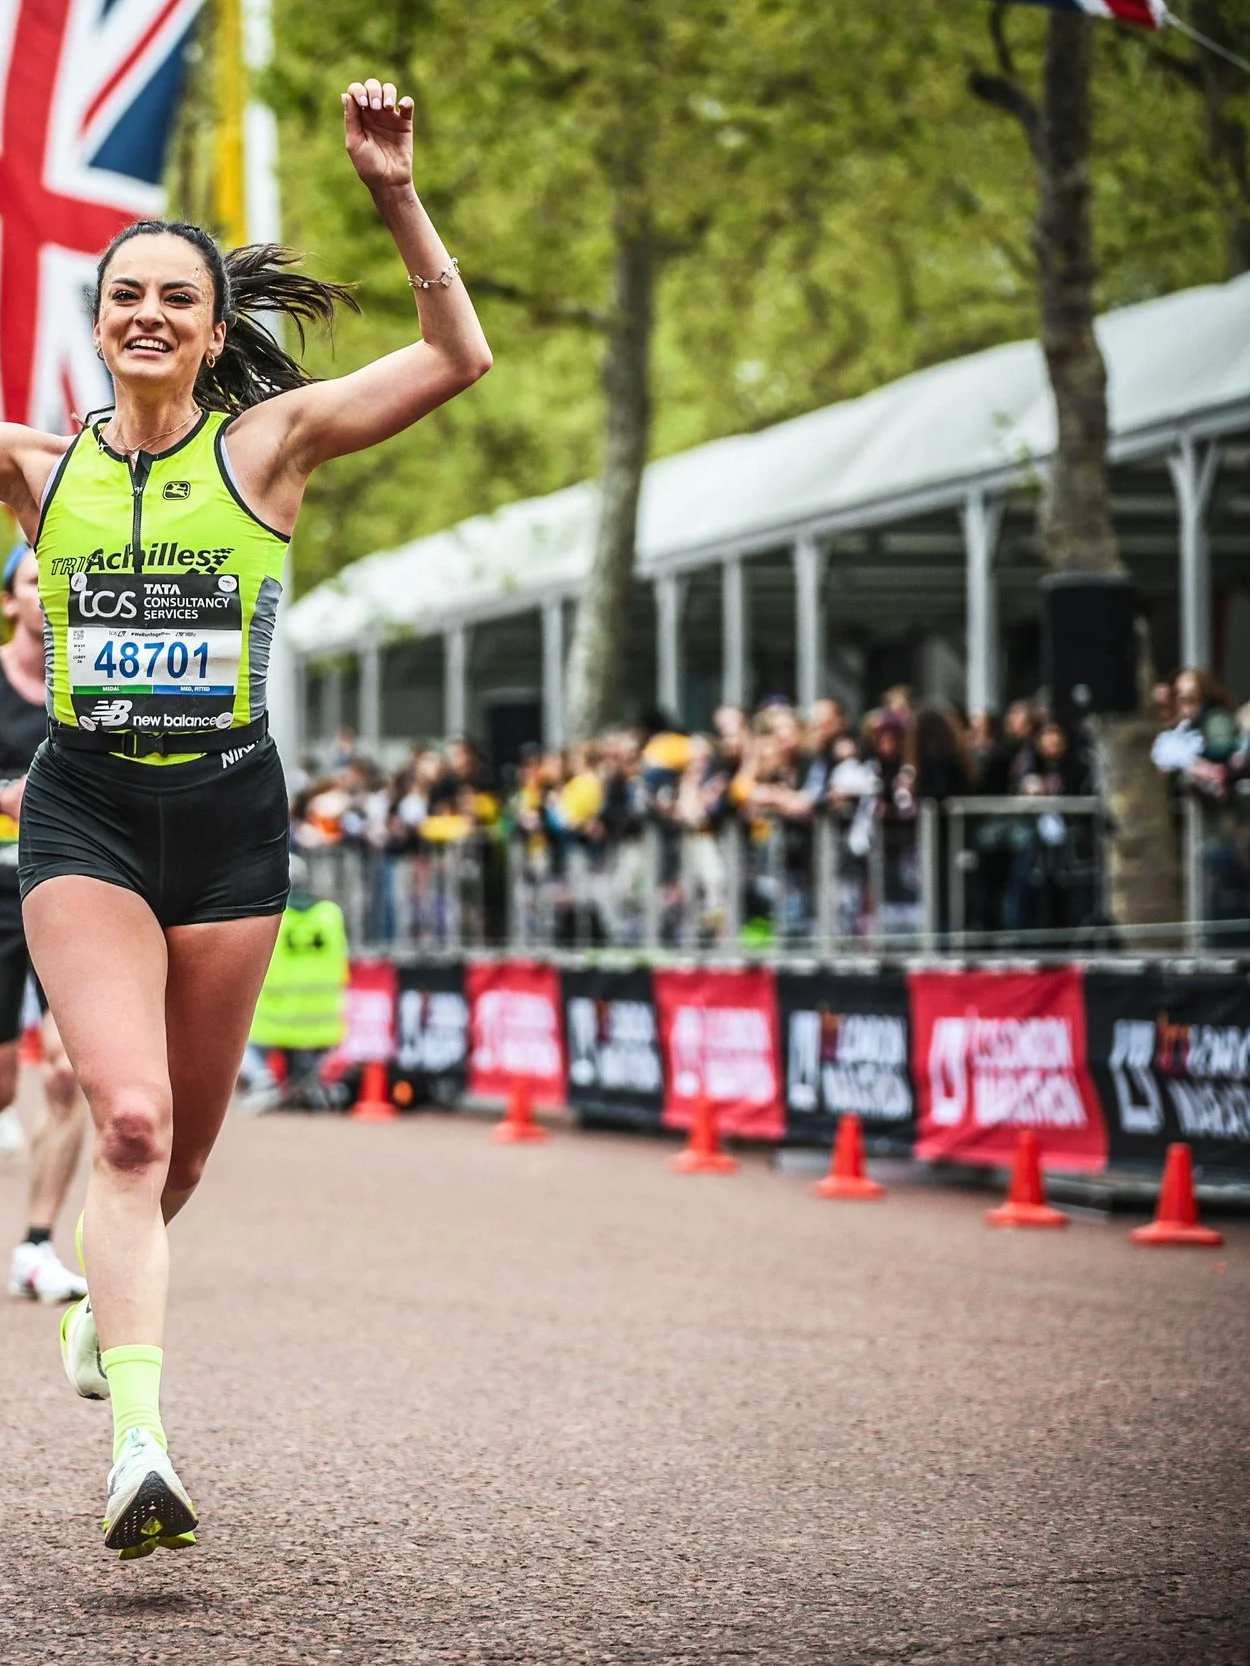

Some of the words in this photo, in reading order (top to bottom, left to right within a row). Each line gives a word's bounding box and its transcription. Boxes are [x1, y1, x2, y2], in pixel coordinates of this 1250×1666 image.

[143, 583, 181, 595] TATA
[79, 589, 137, 618] tcs
[143, 597, 230, 609] CONSULTANCY
[143, 609, 199, 620] SERVICES
[94, 640, 208, 679] 48701
[133, 715, 160, 726] new
[163, 714, 217, 727] balance
